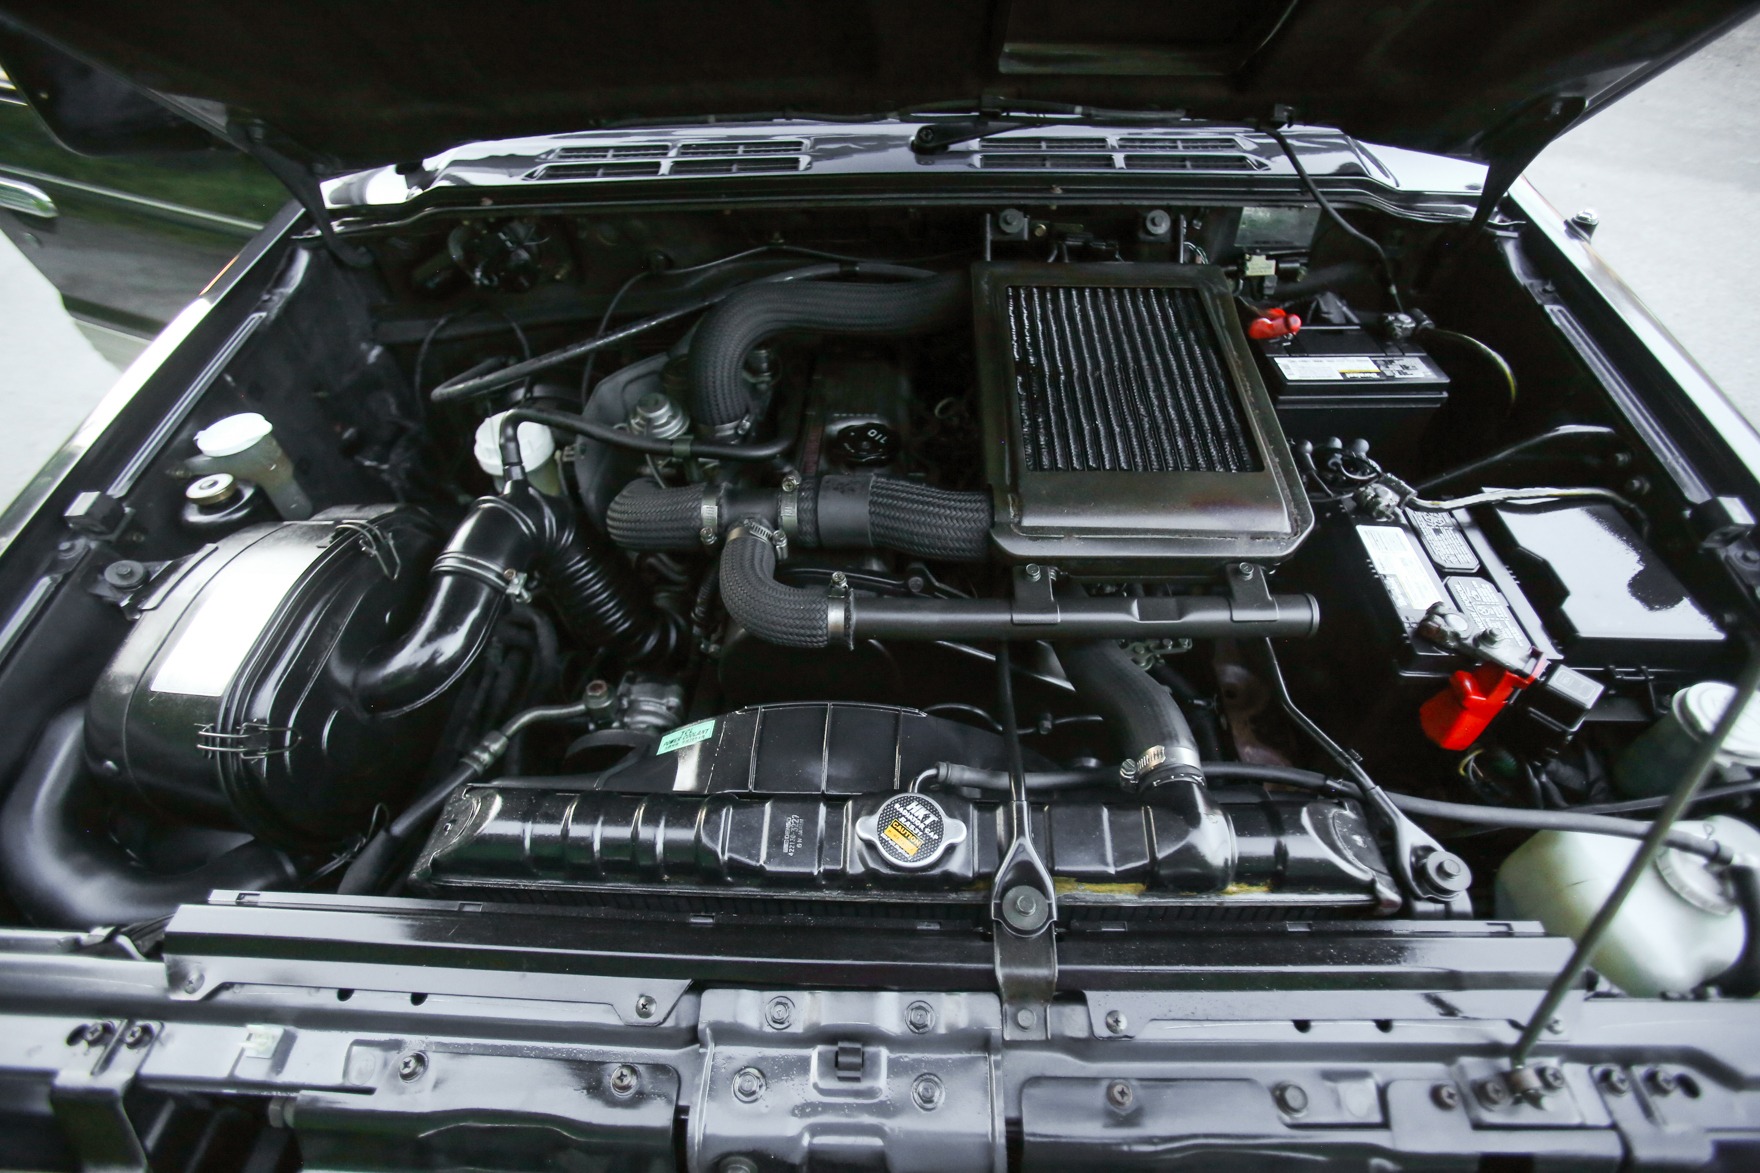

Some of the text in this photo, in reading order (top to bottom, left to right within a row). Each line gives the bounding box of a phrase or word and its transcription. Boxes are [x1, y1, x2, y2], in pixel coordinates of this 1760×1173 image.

[867, 428, 887, 443] OIL
[894, 803, 925, 830] RADIATOR
[924, 827, 939, 840] CAP
[905, 801, 938, 826] HKT
[892, 822, 922, 846] CAUTION
